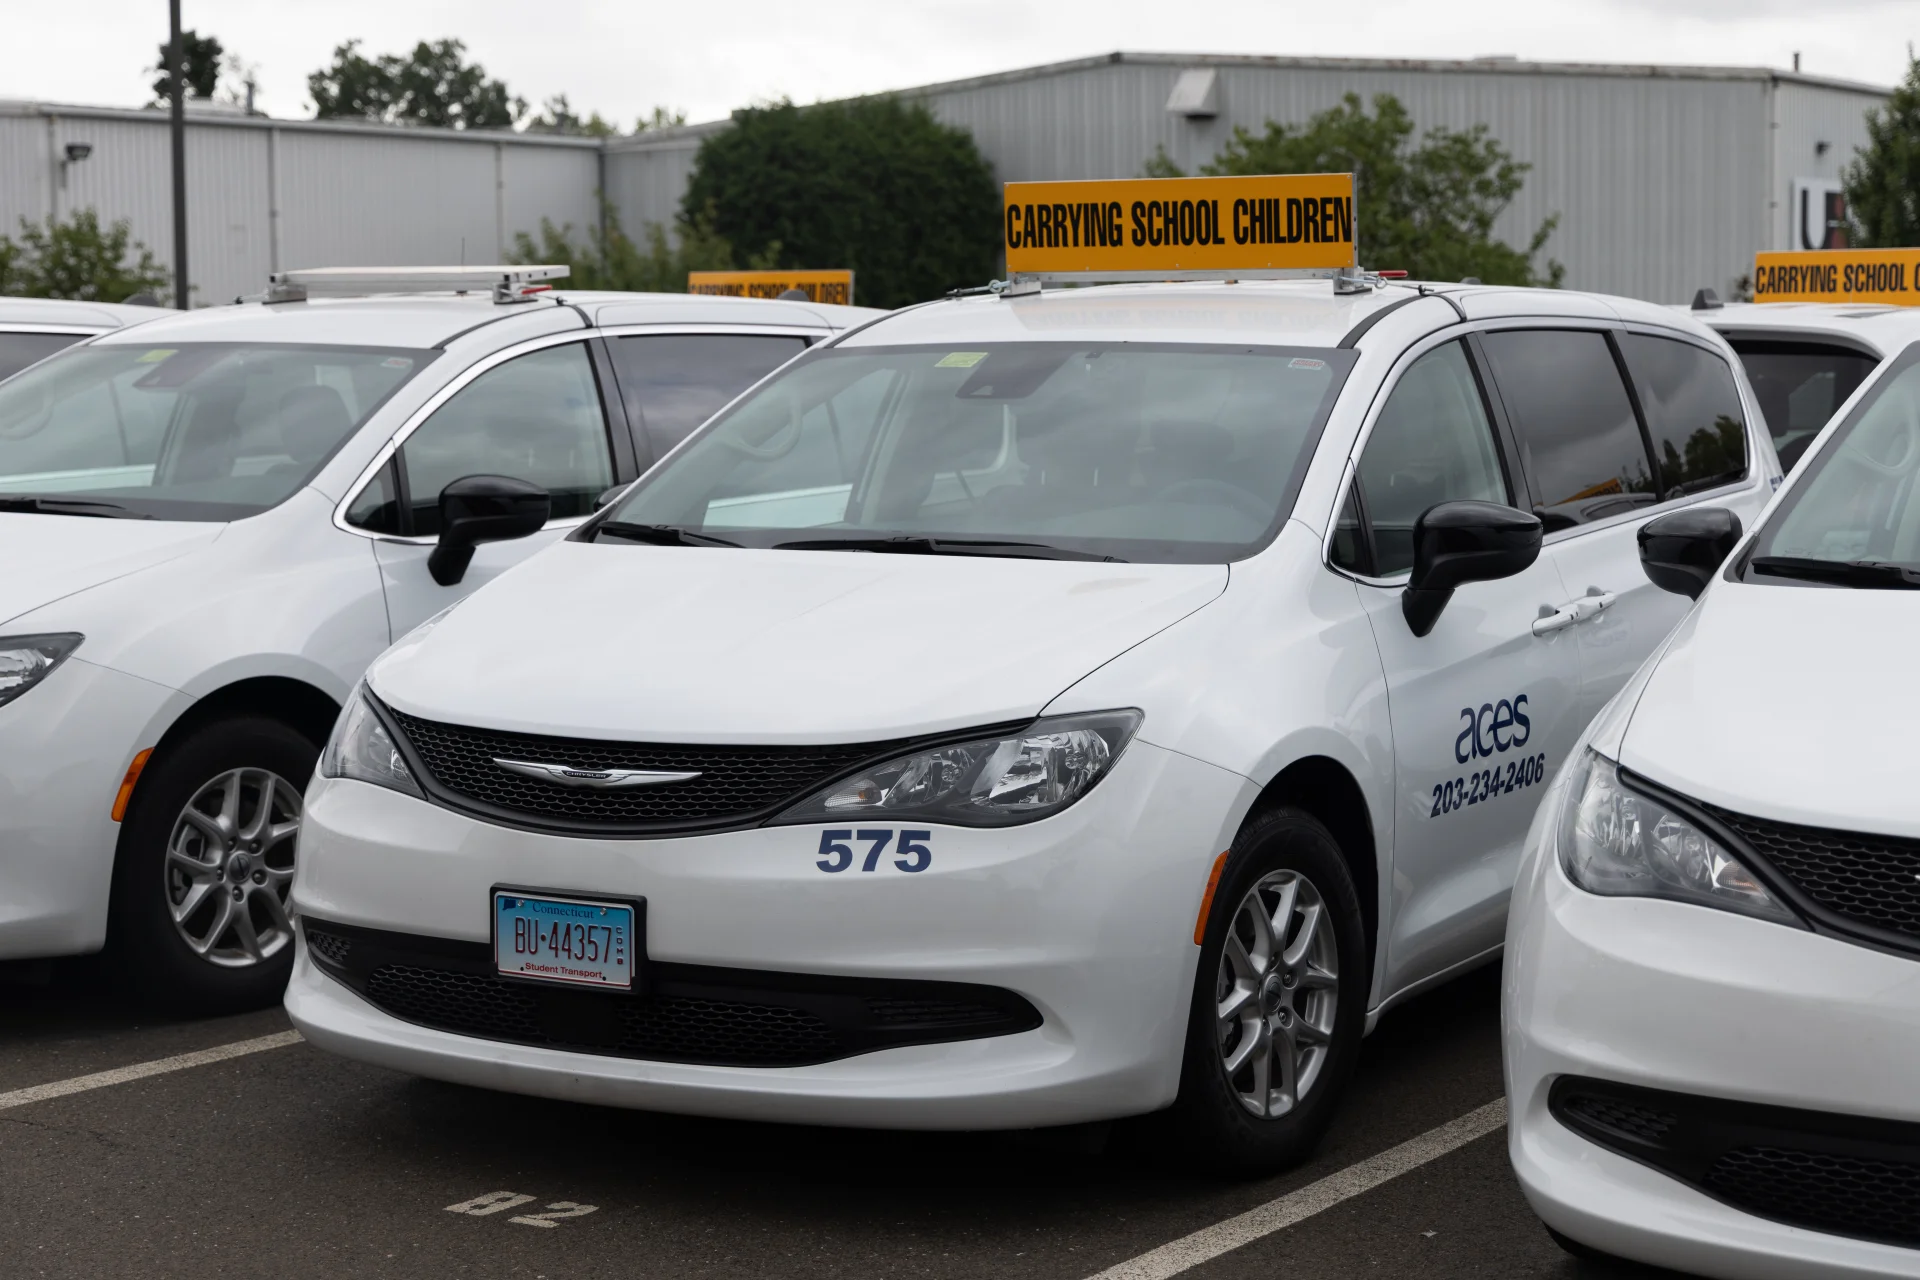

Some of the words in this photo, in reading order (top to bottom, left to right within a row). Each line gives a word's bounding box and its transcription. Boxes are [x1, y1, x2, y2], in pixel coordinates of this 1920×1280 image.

[1007, 201, 1123, 249] CARRYING
[1131, 199, 1225, 247] SCHOOL
[1233, 196, 1352, 246] CHILDREN
[1756, 264, 1837, 294] CARRYING
[1843, 262, 1908, 293] SCHOOL
[1454, 693, 1531, 764] aces
[566, 771, 607, 779] CHRYSLER
[1430, 752, 1545, 819] 203-234-2406
[816, 829, 932, 873] 575
[532, 902, 594, 919] Connecticut
[525, 962, 558, 974] Student
[560, 966, 602, 979] Transport
